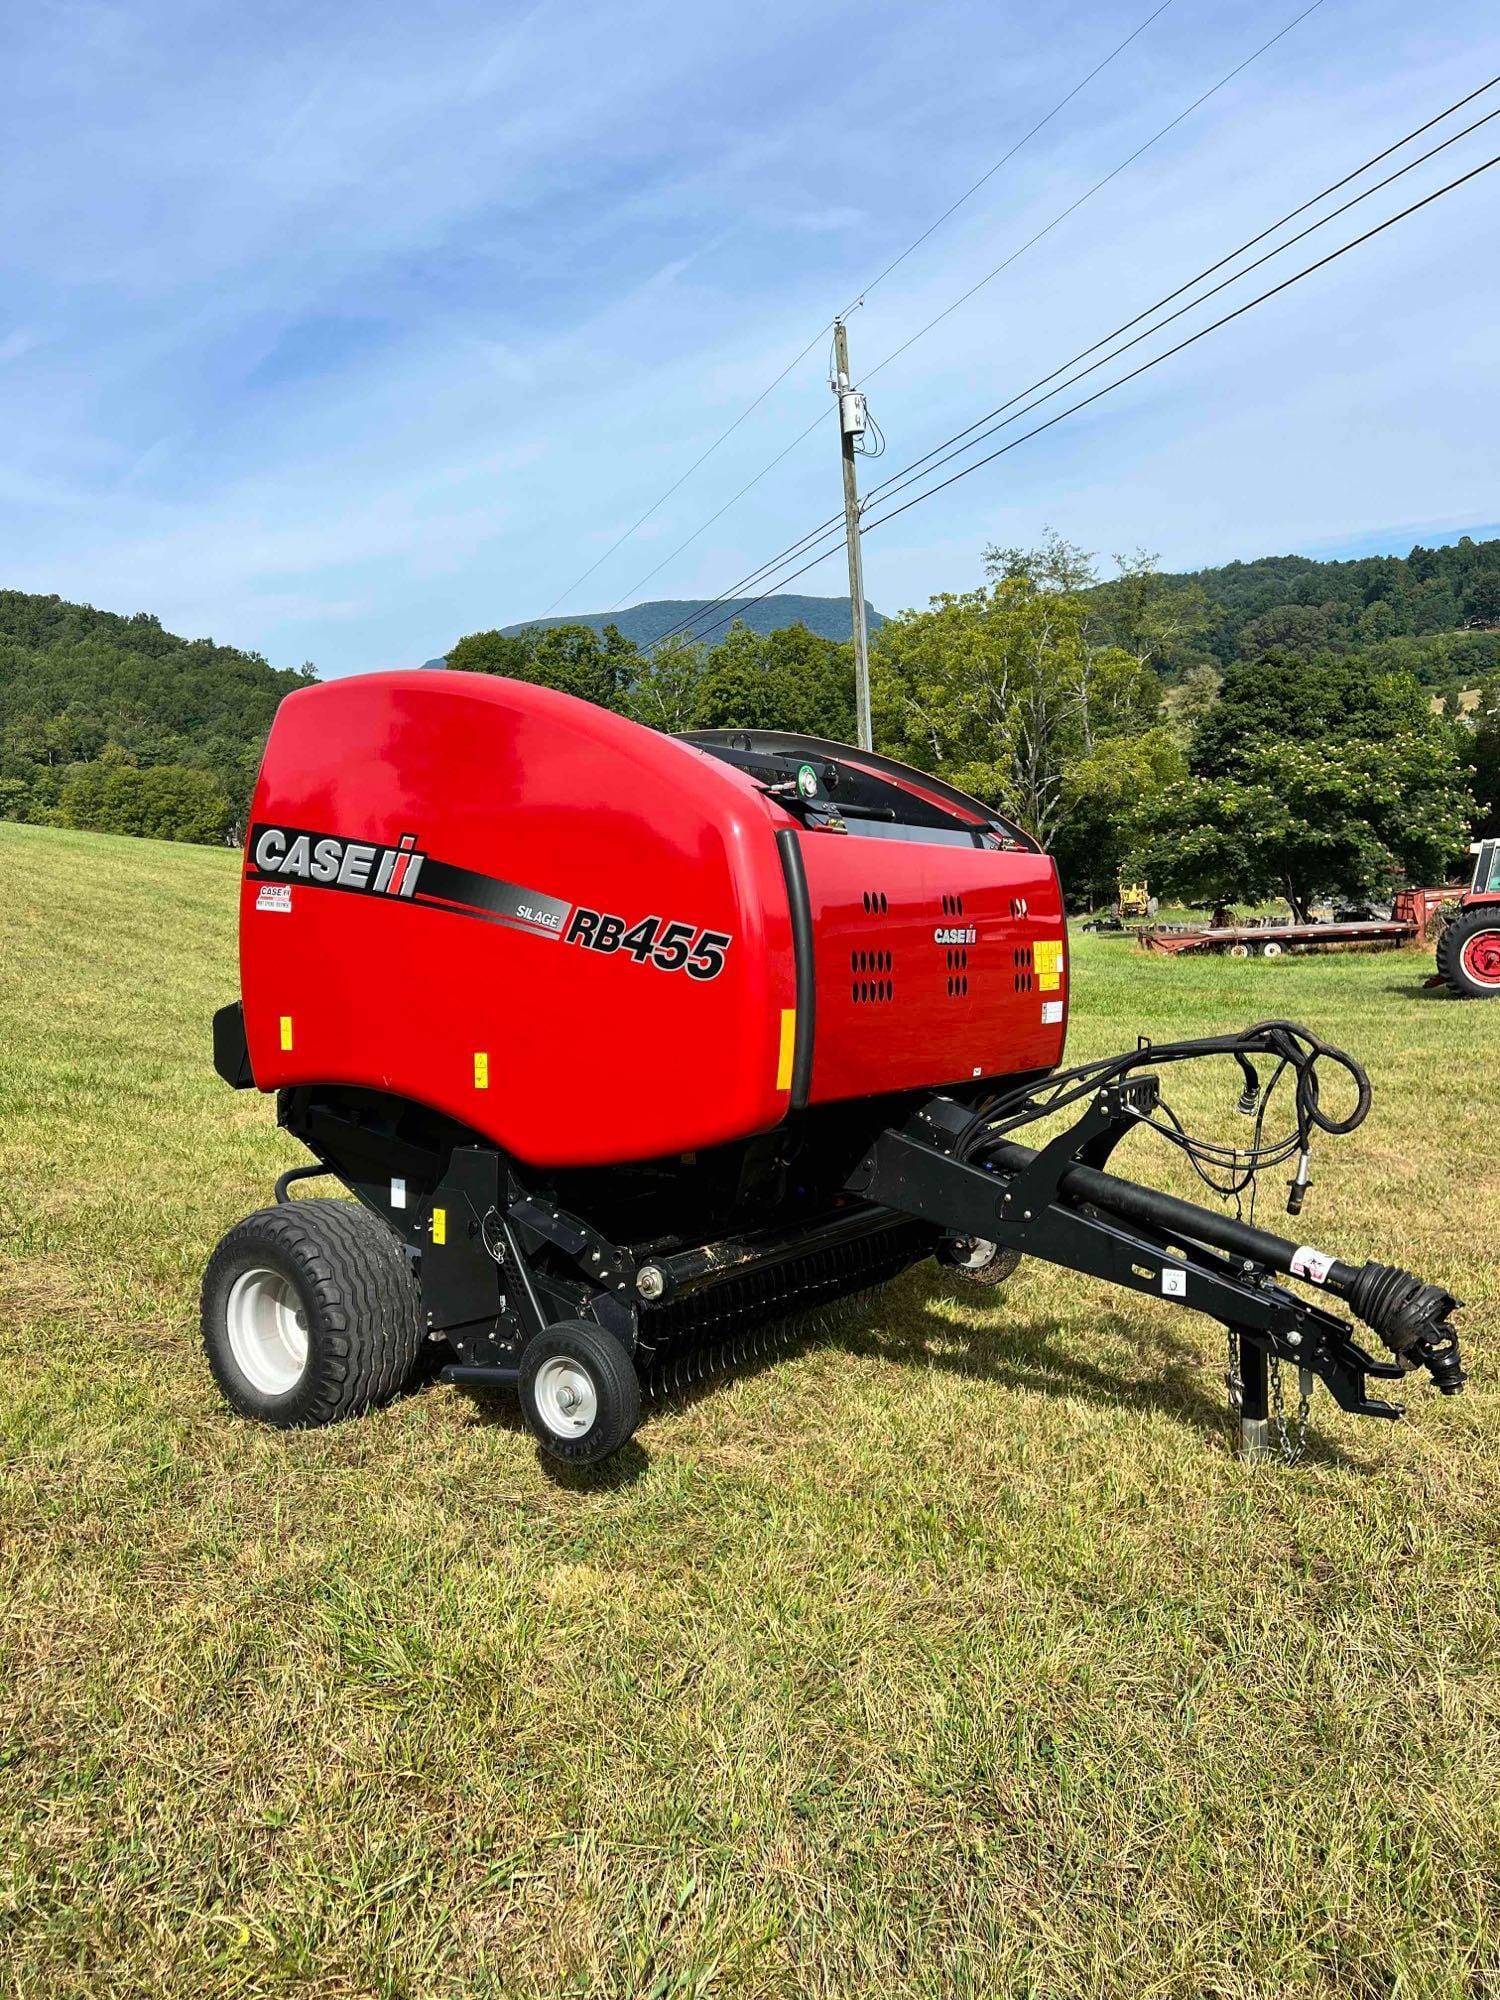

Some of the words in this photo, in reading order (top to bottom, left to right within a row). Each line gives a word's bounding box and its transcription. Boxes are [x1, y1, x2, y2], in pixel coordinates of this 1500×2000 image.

[256, 829, 376, 889] CASE
[261, 886, 283, 896] CASE
[516, 905, 560, 928] SILAGE
[564, 906, 733, 981] RB455
[934, 928, 966, 944] CASE
